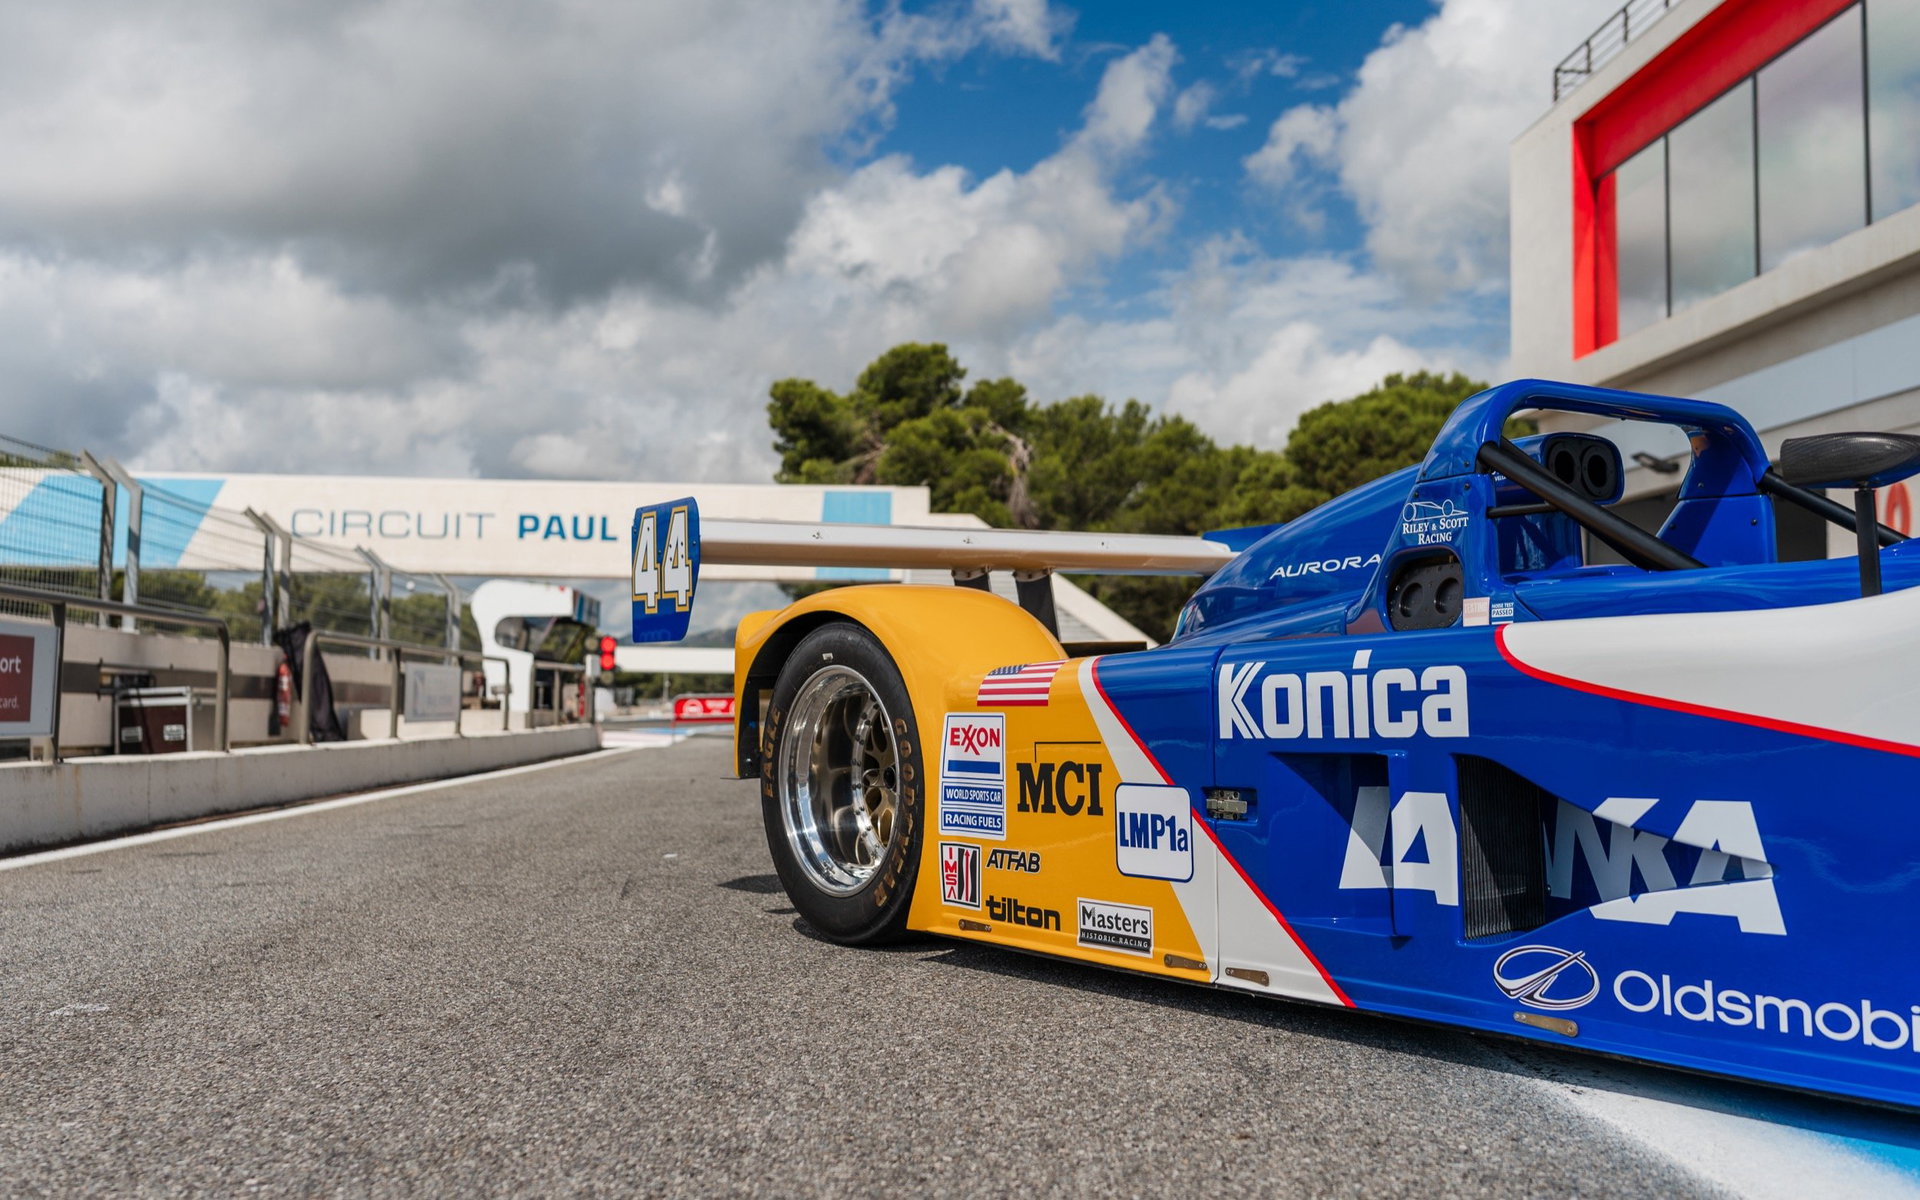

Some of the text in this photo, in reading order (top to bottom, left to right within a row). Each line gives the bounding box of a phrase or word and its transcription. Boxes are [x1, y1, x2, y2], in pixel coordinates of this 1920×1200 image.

[290, 508, 618, 541] CIRCUIT PAUL
[1402, 522, 1430, 535] RILEY
[1439, 517, 1469, 529] SCOTT
[1417, 532, 1452, 545] RACING
[632, 505, 693, 615] 44
[1269, 553, 1382, 580] AURORA
[1218, 649, 1470, 739] Konica
[763, 706, 782, 798] EAGLE
[950, 724, 1000, 755] EXXON
[946, 788, 1001, 803] WORLD SPORTS CAR
[1016, 761, 1104, 816] MCI
[874, 718, 915, 908] GOODYEAR
[945, 813, 1002, 829] RACING FUELS
[1119, 812, 1189, 852] LMP1a
[944, 847, 957, 900] IMSA
[986, 848, 1042, 873] ATFAB
[986, 895, 1061, 931] tilton
[1081, 905, 1149, 935] Masters
[1081, 931, 1149, 948] HISTORIC RACING
